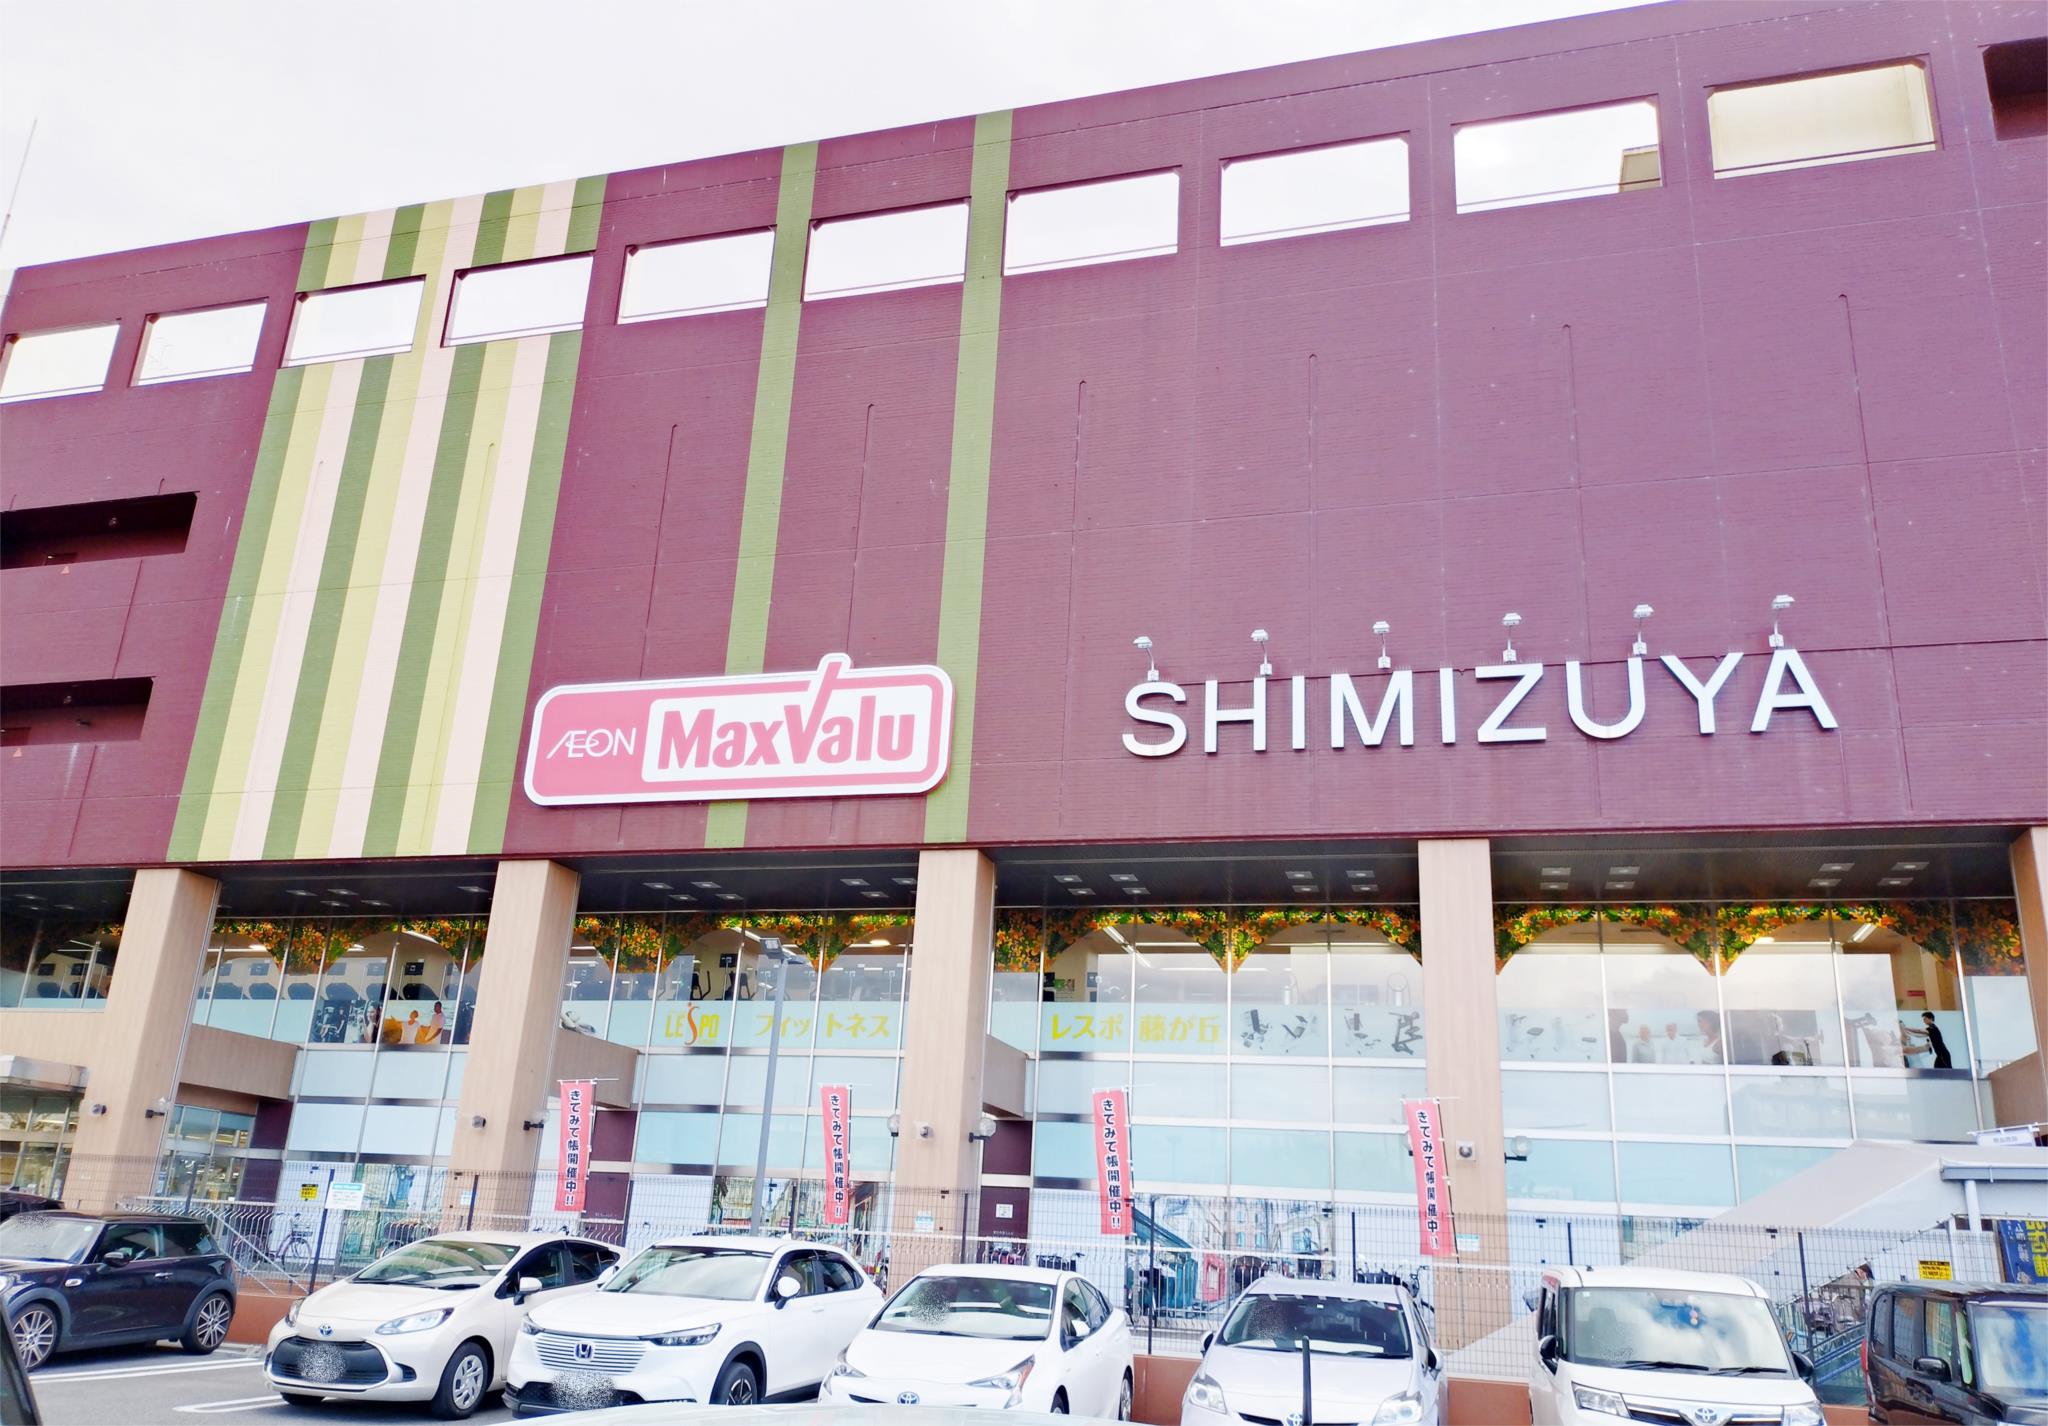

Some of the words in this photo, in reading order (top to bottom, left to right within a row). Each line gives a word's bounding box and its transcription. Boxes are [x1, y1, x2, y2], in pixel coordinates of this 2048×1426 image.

[657, 661, 916, 770] MaxValu
[1121, 647, 1838, 757] SHIMIZUYA
[754, 1012, 890, 1039] フィットネス
[1051, 1013, 1124, 1042] レスポ
